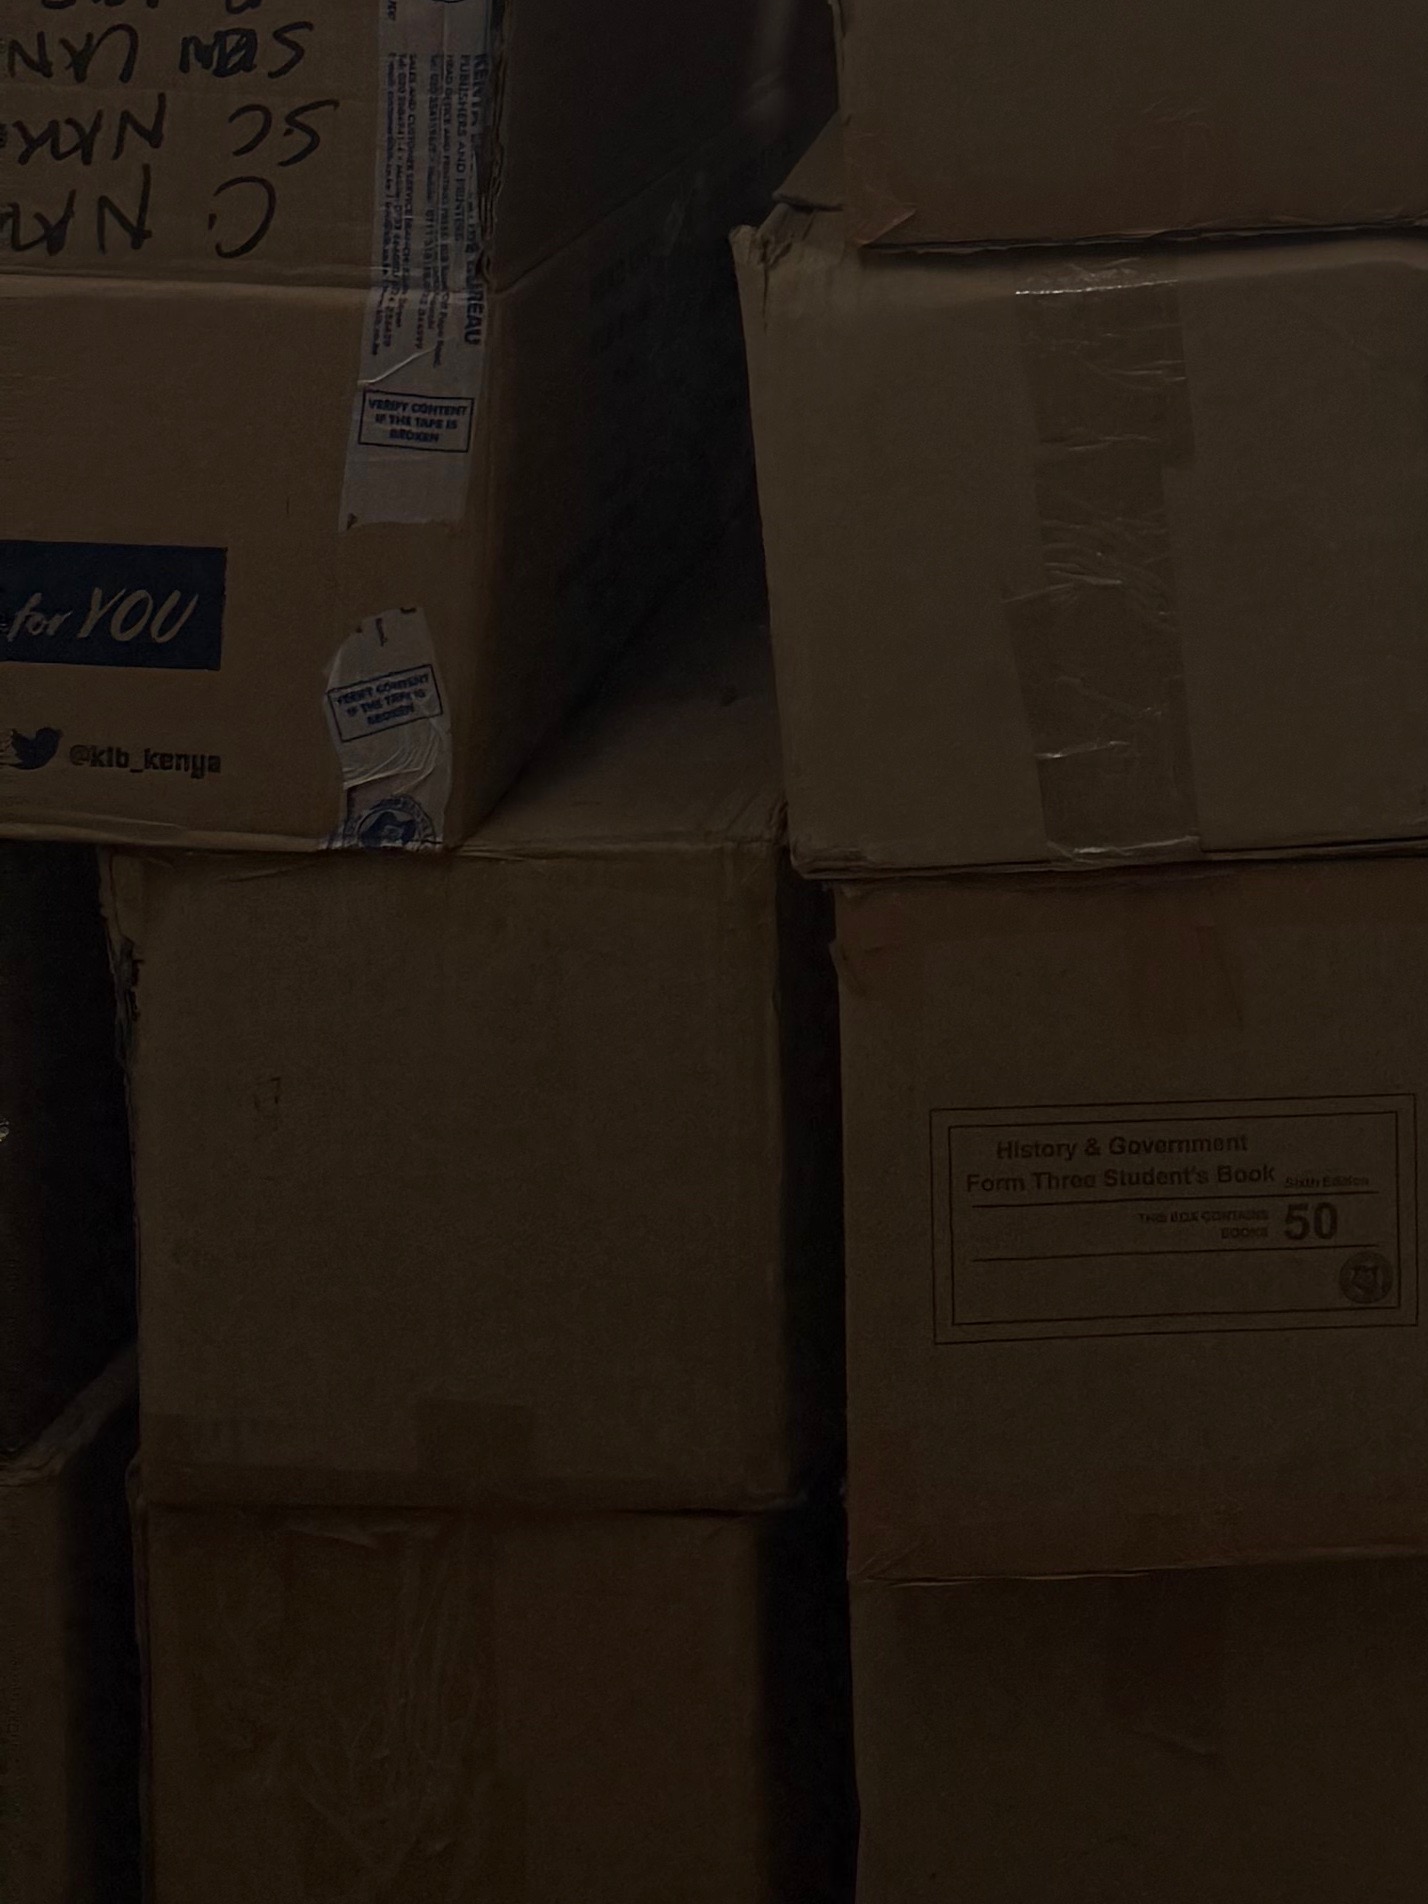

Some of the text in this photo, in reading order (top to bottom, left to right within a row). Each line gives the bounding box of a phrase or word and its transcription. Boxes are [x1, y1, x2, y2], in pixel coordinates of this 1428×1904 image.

[456, 54, 471, 137] PUBLISHERS
[455, 141, 467, 174] AND
[368, 398, 468, 416] VERIFY CONTENT
[374, 413, 458, 430] IF THE TAPE IS
[388, 428, 440, 443] BROKEN
[6, 586, 199, 644] for YOU
[69, 744, 222, 779] @klb_kenya
[996, 1133, 1249, 1161] History & Government
[966, 1163, 1275, 1194] Form Three Student's Book
[1283, 1201, 1339, 1242] 50
